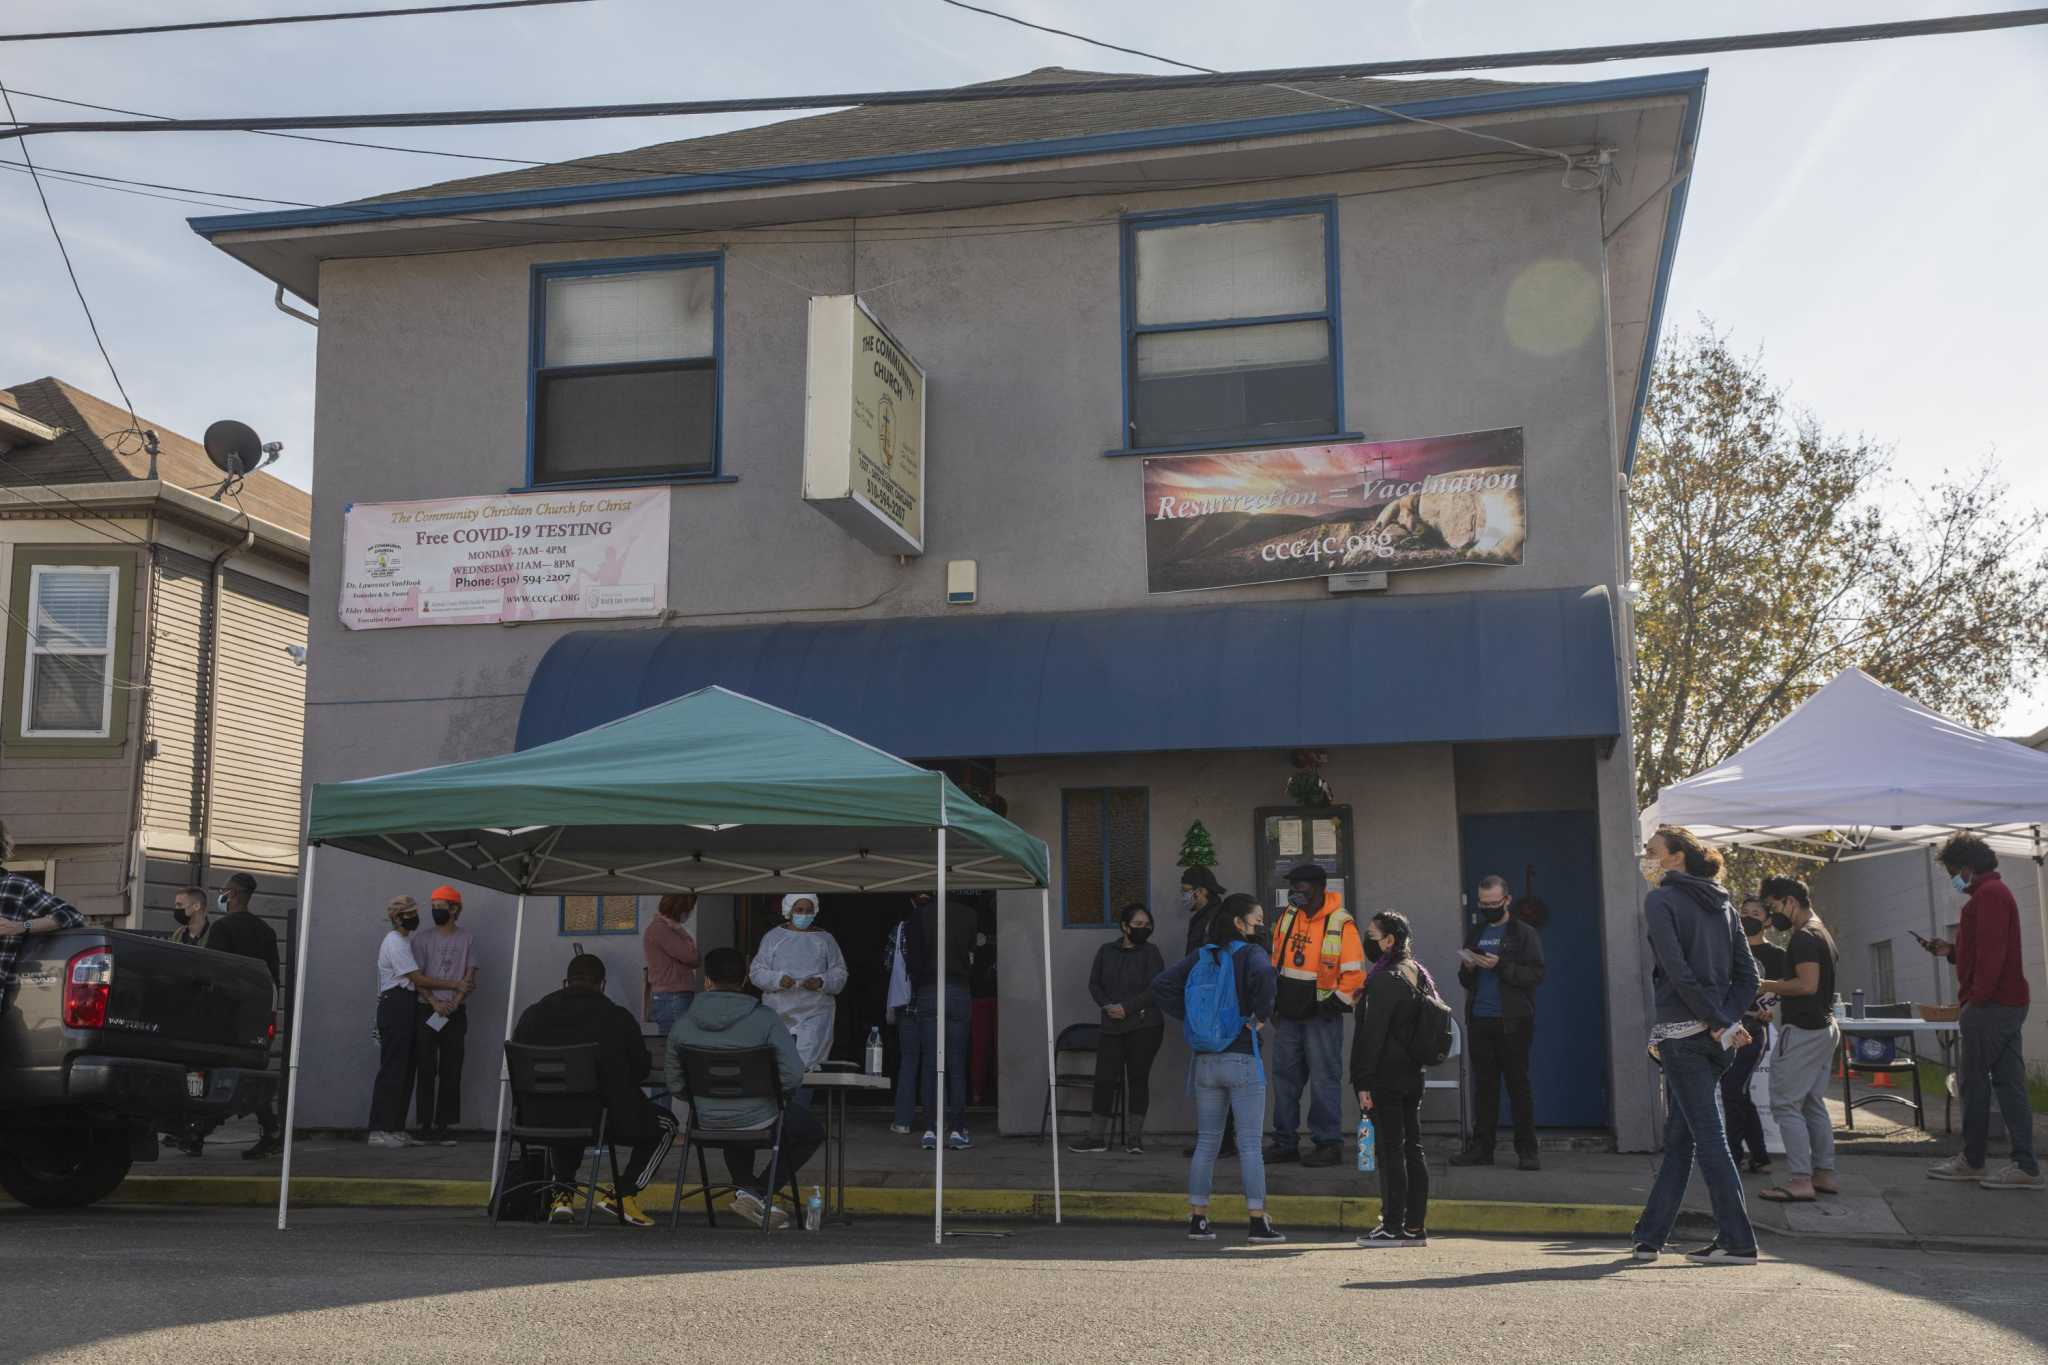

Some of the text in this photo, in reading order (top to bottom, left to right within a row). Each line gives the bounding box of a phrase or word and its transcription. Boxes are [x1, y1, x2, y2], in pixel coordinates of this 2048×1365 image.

[862, 336, 914, 400] THE COMMUNITY
[874, 361, 902, 400] CHURCH
[1154, 485, 1319, 521] Resurrection
[1361, 472, 1518, 501] Vaccination
[392, 499, 632, 523] The Community Christian Church for Christ
[416, 521, 612, 545] Free COVID-19 TESTING
[545, 545, 567, 555] 4PM
[1261, 533, 1395, 562] ccc4c.org
[452, 562, 514, 575] WEDNESDAY
[554, 560, 575, 569] 8PM
[455, 578, 495, 588] Phone:
[522, 574, 571, 585] 594-2207
